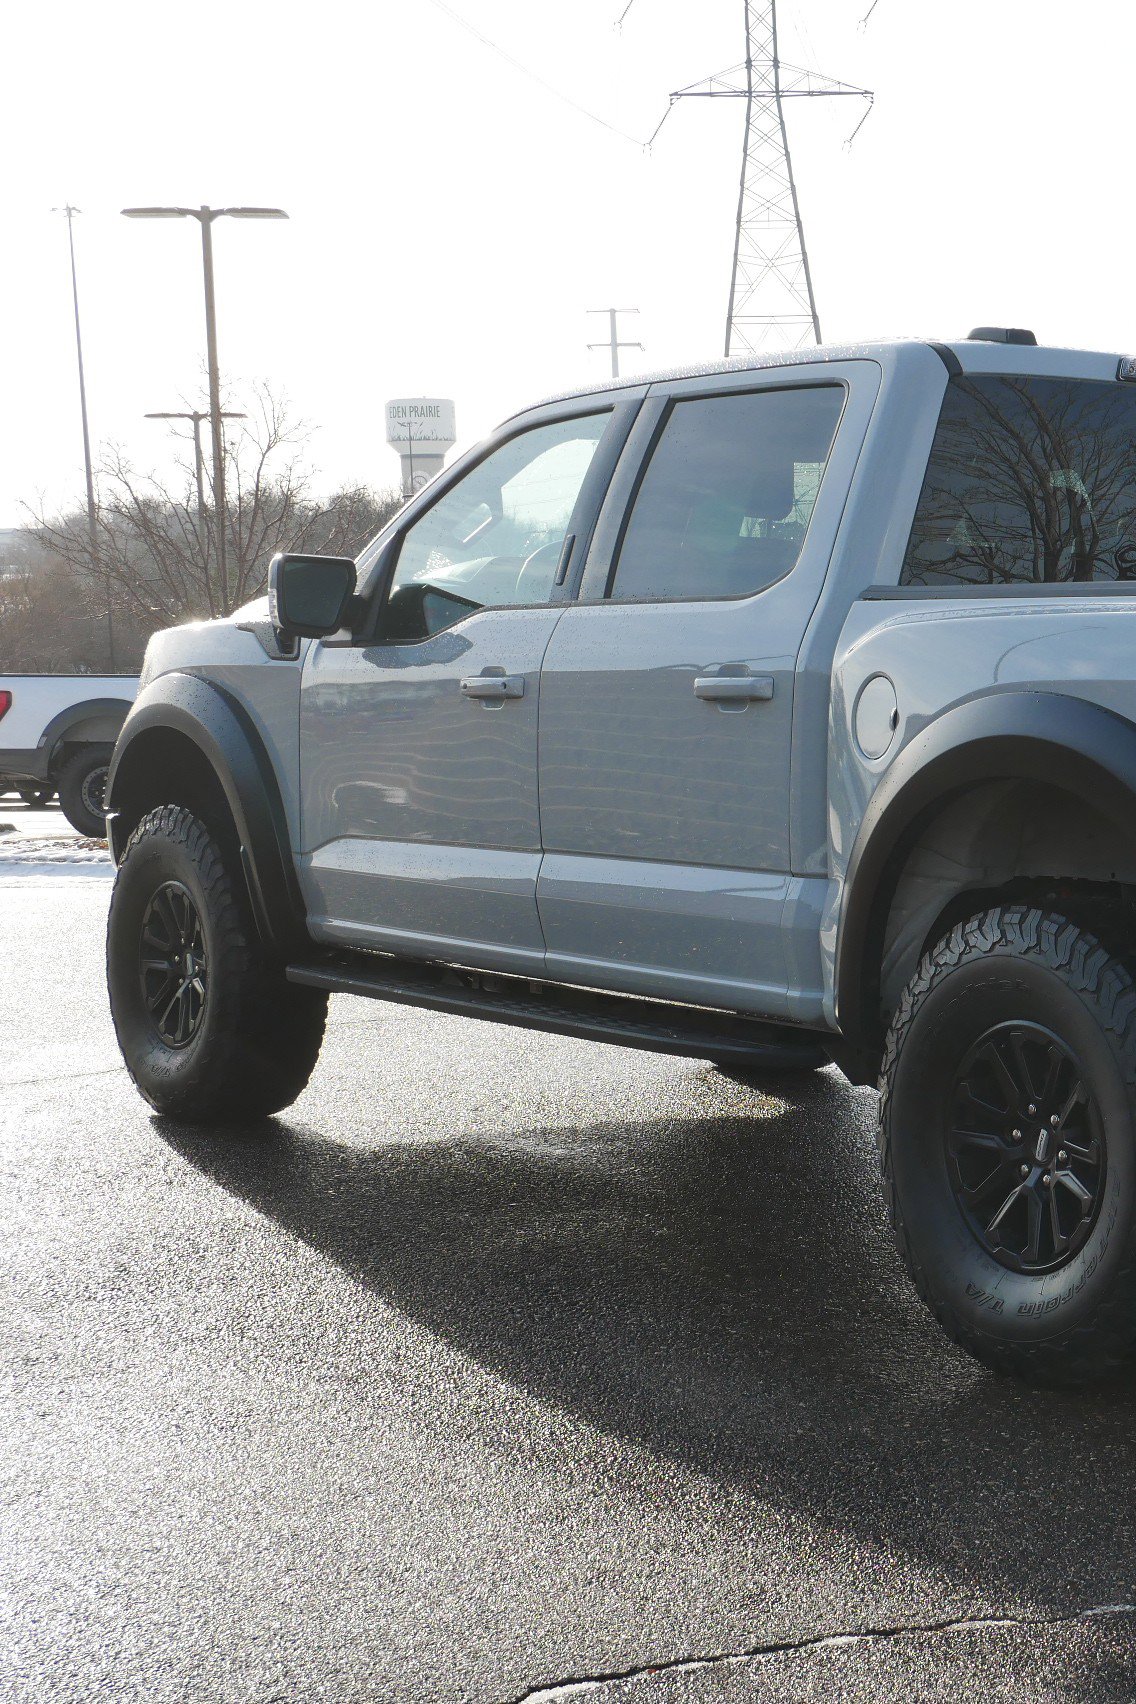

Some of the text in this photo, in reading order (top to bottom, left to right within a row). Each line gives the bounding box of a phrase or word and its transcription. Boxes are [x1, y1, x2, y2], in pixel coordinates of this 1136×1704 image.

[389, 405, 441, 419] EDEN PRAIRIE
[965, 1280, 1005, 1315] T/A
